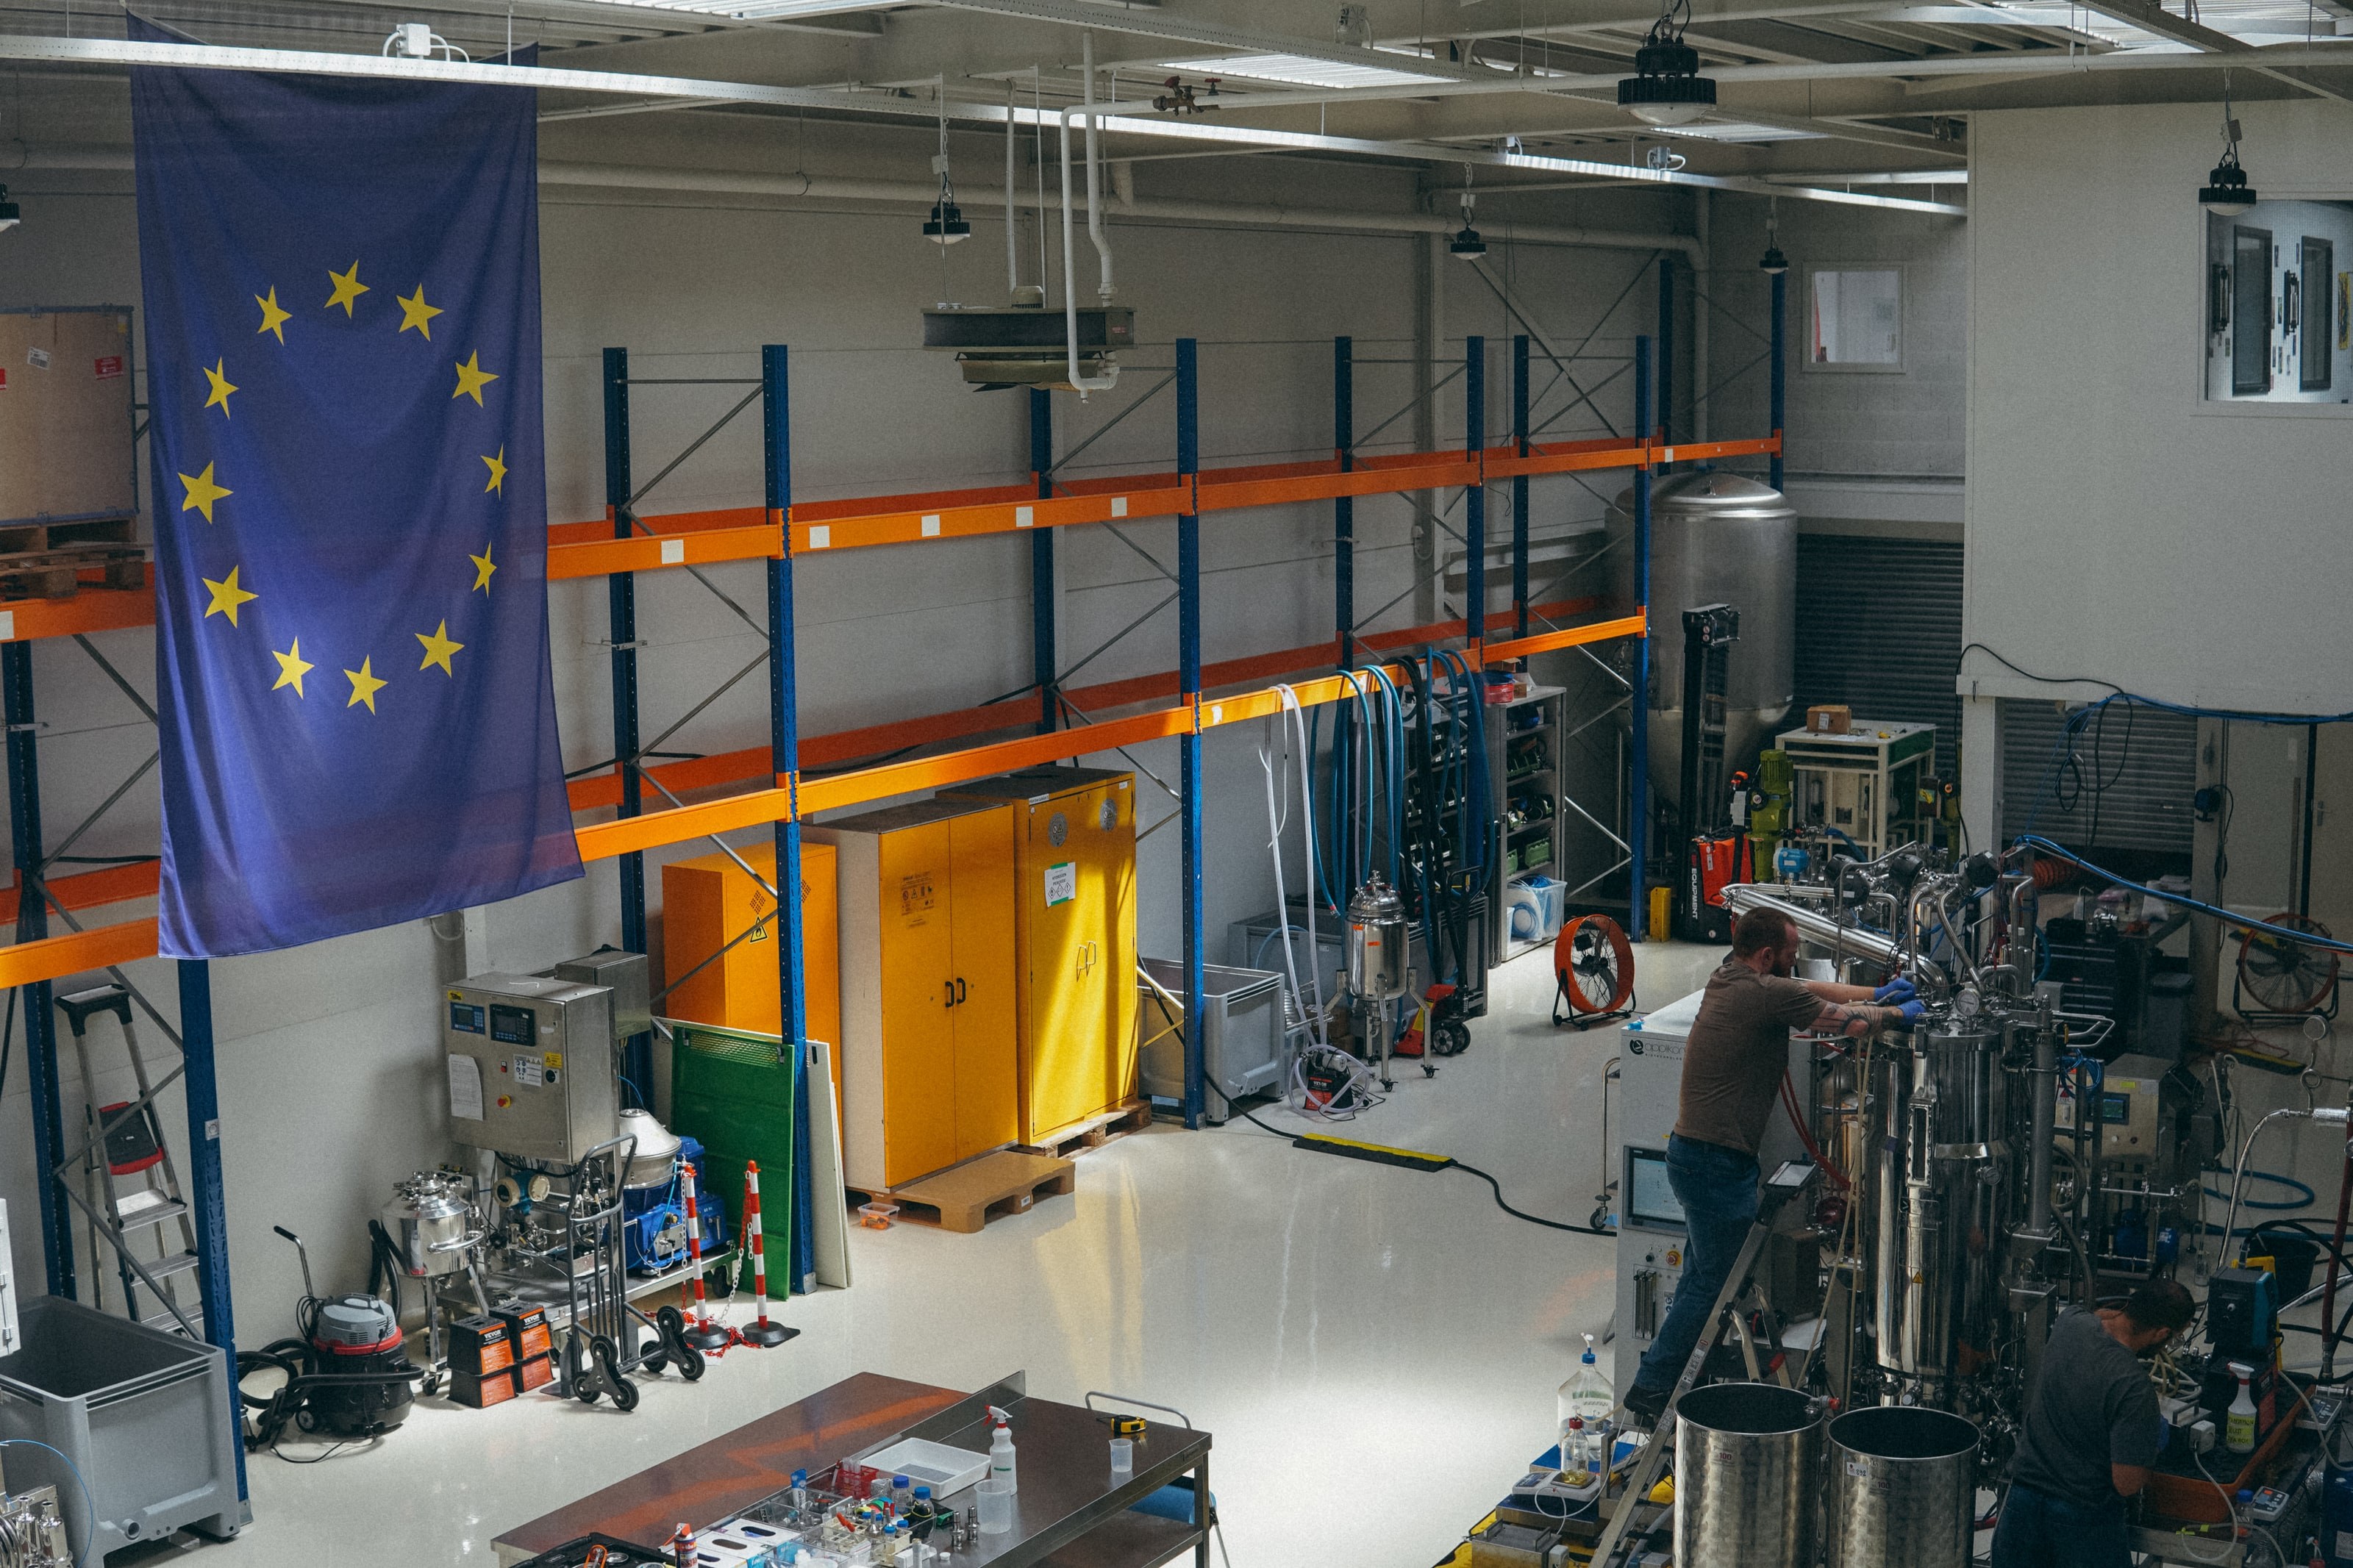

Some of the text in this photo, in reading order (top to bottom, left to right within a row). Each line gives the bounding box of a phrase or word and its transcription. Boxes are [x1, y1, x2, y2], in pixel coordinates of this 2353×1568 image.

[1645, 1043, 1686, 1054] applikon
[524, 1314, 540, 1324] VEVOR
[484, 1329, 501, 1339] VEVOR
